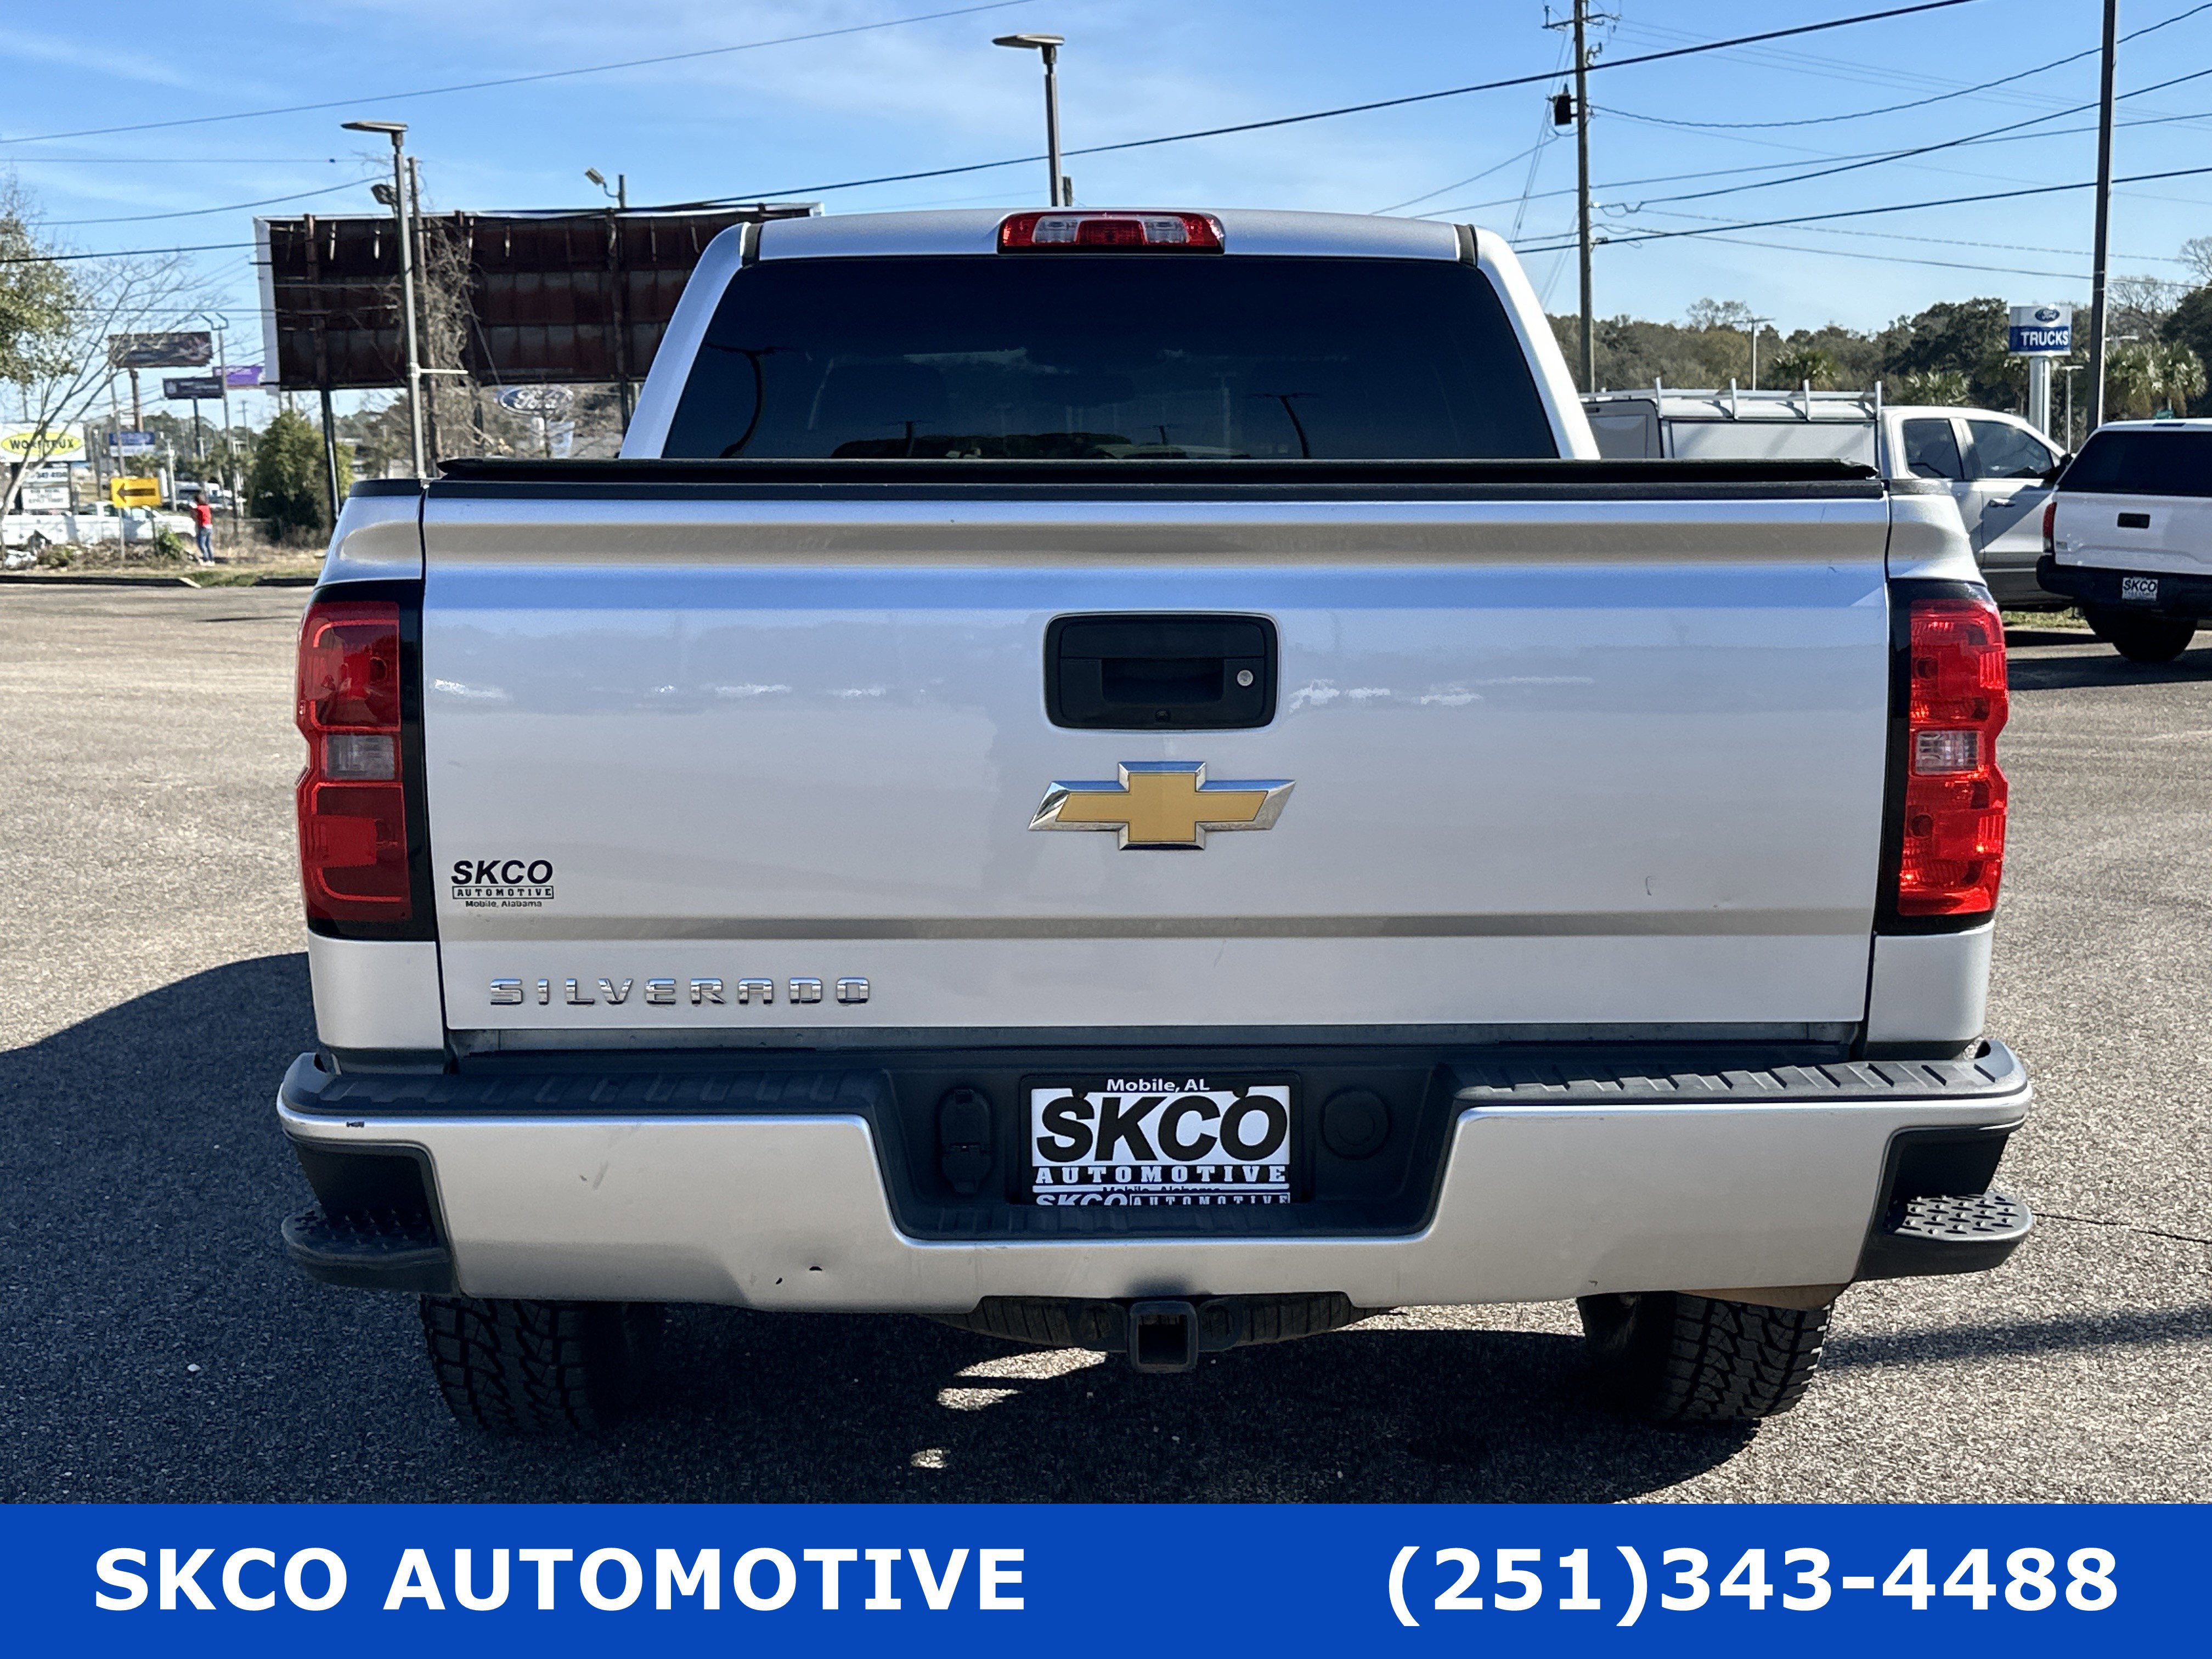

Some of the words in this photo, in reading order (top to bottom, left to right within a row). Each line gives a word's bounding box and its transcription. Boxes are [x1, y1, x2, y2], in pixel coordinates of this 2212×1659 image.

[2020, 330, 2069, 346] TRUCKS
[2123, 579, 2157, 592] SKCO
[450, 860, 554, 885] SKCO
[457, 888, 552, 897] AUTOMOTIVE
[489, 977, 871, 1005] SILVERADO
[1106, 1079, 1180, 1093] Mobile,
[1184, 1078, 1210, 1091] AL
[1036, 1095, 1288, 1163] SKCO
[1035, 1165, 1286, 1184] AUTOMOTIVE
